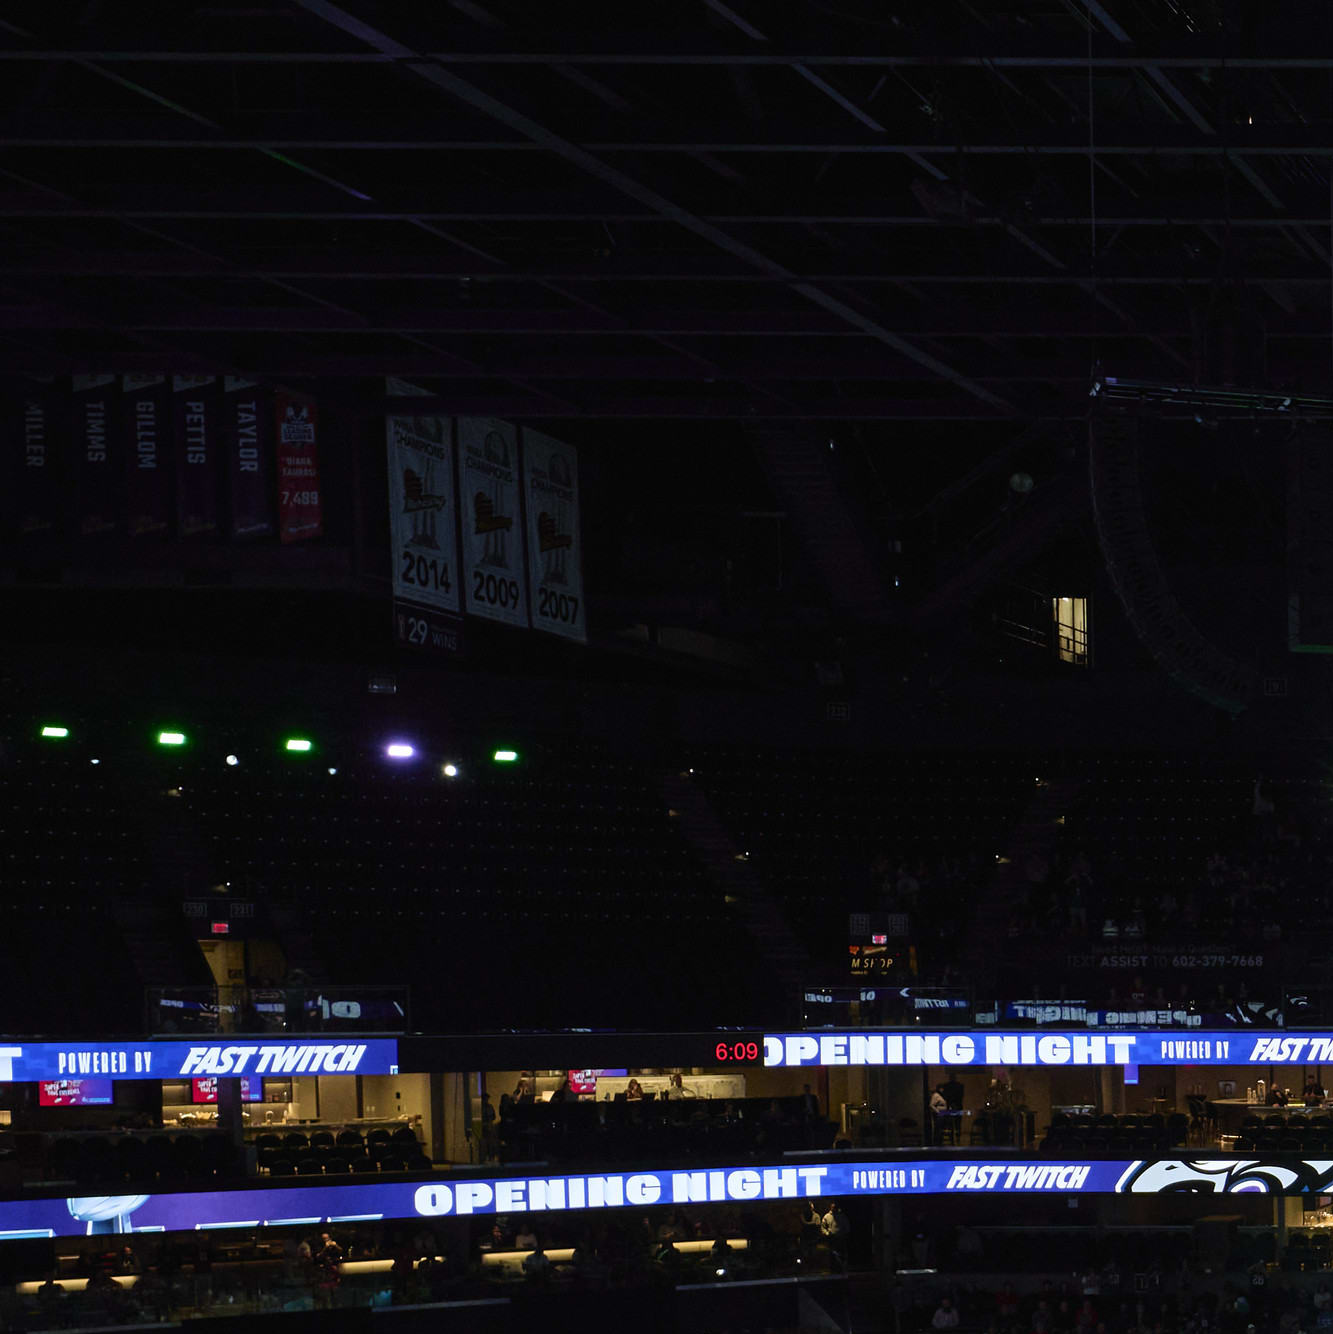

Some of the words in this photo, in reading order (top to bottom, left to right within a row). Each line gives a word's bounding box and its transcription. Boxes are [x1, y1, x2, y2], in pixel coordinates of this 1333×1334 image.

[86, 400, 106, 464] TIMMS
[136, 400, 157, 470] GILLOM
[186, 400, 206, 465] PETTIS
[237, 400, 259, 473] TAYLOR
[403, 551, 451, 594] 2014
[473, 570, 520, 610] 2009
[539, 588, 579, 625] 2007
[408, 617, 428, 645] 29
[431, 631, 457, 651] WINS
[1100, 955, 1148, 968] ASSIST
[58, 1051, 127, 1075] POWERED
[134, 1051, 153, 1073] BY
[179, 1045, 258, 1075] FAST
[254, 1044, 367, 1072] TWITCH
[715, 1042, 759, 1061] 6:09
[985, 1035, 1136, 1065] NIGHT
[1161, 1040, 1211, 1060] POWERED
[1214, 1040, 1230, 1059] BY
[1249, 1038, 1310, 1062] FAST
[414, 1174, 661, 1217] OPENING
[672, 1167, 828, 1203] NIGHT
[852, 1169, 906, 1190] POWERED
[911, 1168, 925, 1188] BY
[945, 1166, 1007, 1190] FAST
[1004, 1165, 1091, 1189] TWITCH
